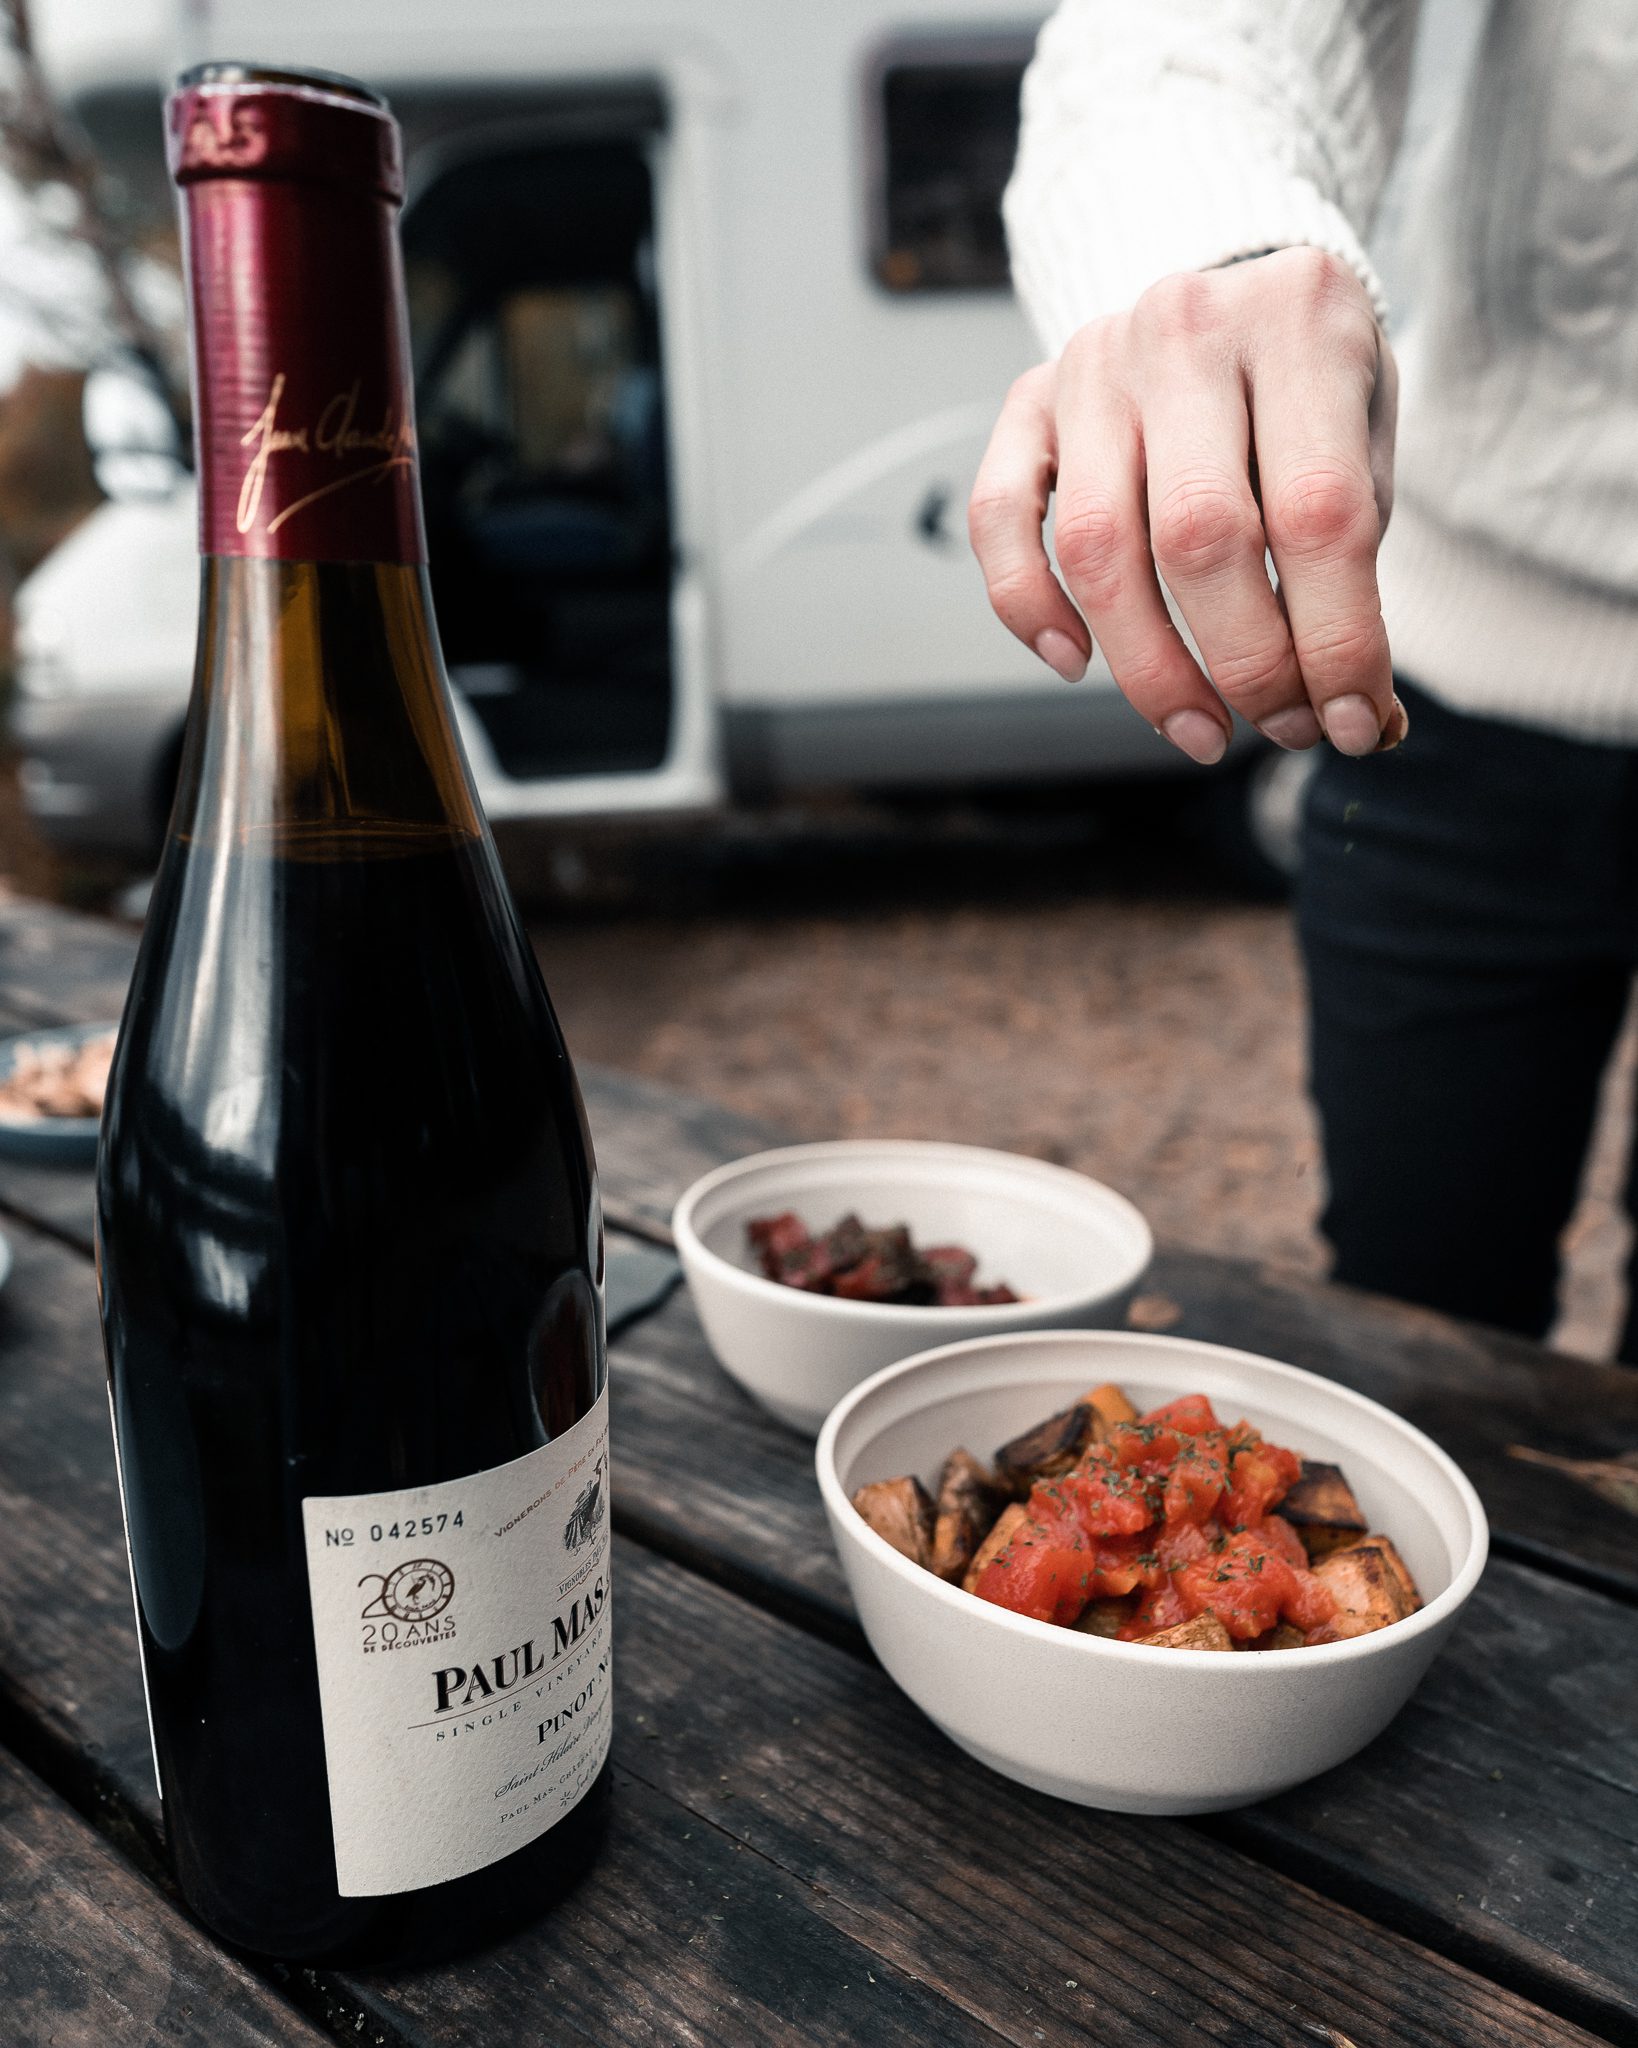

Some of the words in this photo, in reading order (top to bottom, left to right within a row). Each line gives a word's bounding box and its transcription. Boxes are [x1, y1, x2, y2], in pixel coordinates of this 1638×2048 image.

[370, 1510, 464, 1542] 042574
[494, 1489, 552, 1537] VIGNERONS
[559, 1559, 593, 1595] VIGNOBLES
[361, 1621, 399, 1646] 20
[406, 1615, 456, 1640] ANS
[363, 1645, 376, 1654] DE
[431, 1639, 545, 1714] PAUL
[550, 1576, 604, 1661] MAS
[436, 1701, 522, 1742] SINGLE
[535, 1627, 603, 1698] VINEYARD
[537, 1677, 596, 1746] PINOT
[494, 1760, 540, 1801] Saint
[540, 1731, 581, 1772] Hilaire
[500, 1803, 530, 1824] PAUL
